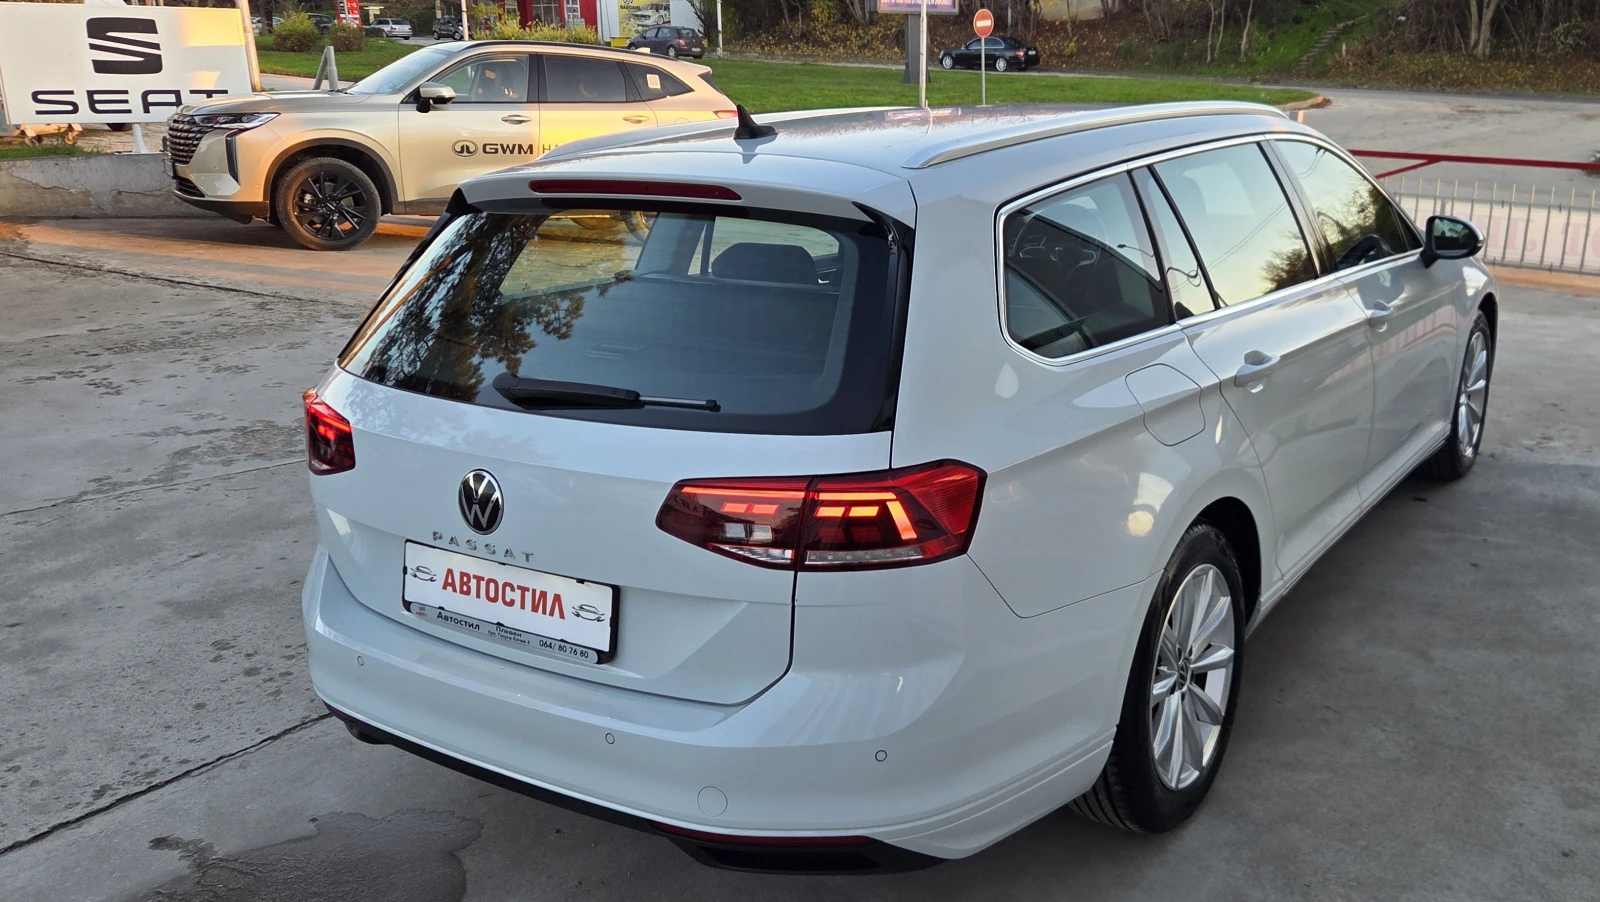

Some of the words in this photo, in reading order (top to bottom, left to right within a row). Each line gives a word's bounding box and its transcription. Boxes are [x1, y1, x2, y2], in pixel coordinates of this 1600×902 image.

[31, 90, 229, 115] SEAT
[482, 143, 534, 155] GWM
[432, 530, 534, 563] PASSAT
[441, 567, 566, 620] АВТОСТИЛ
[436, 611, 480, 631] Автостил
[495, 626, 522, 638] Плевен
[539, 640, 556, 650] 064/
[558, 644, 567, 653] 80
[569, 647, 578, 656] 76
[580, 649, 588, 658] 80
